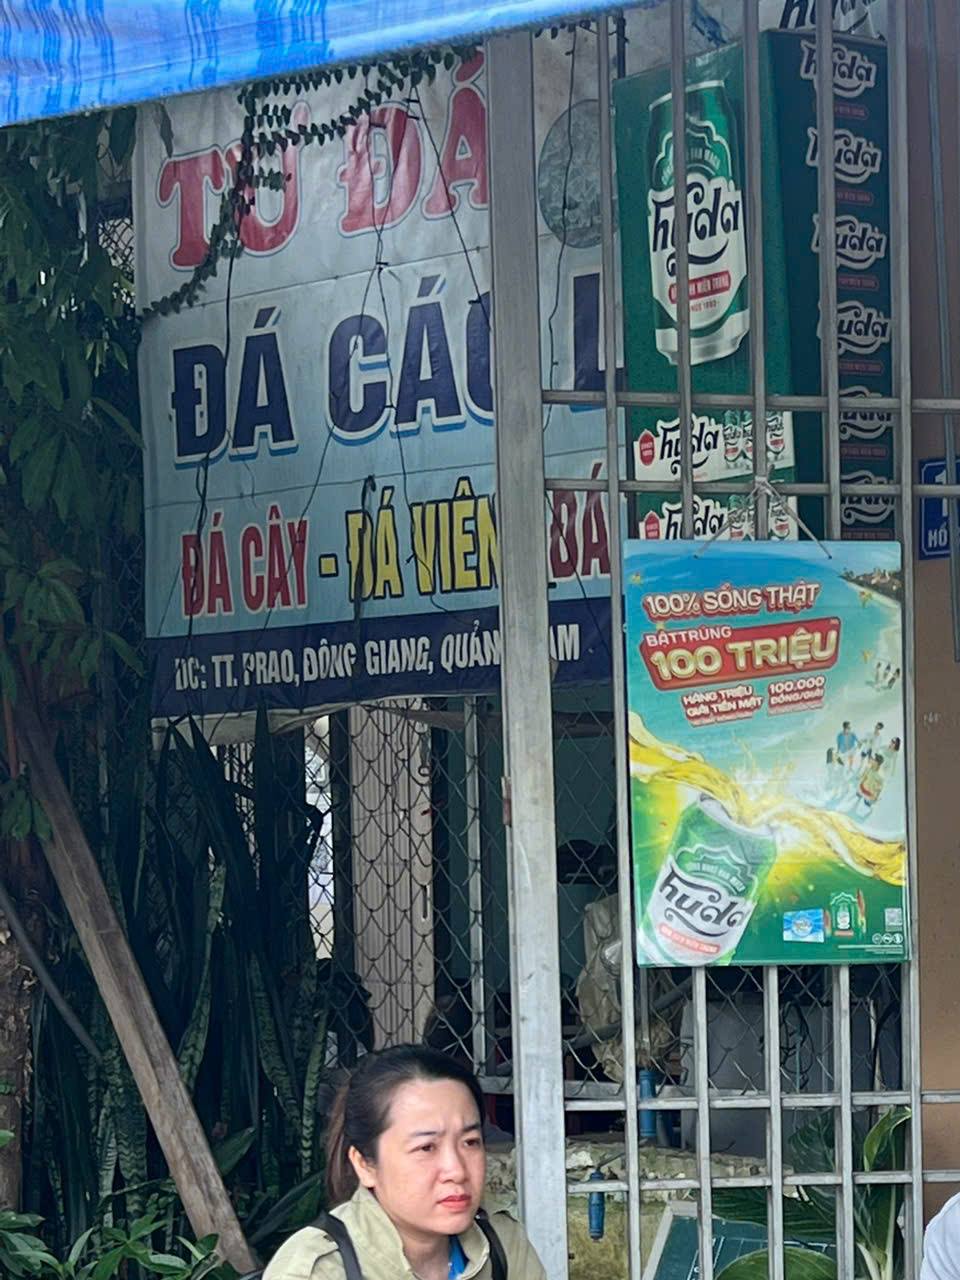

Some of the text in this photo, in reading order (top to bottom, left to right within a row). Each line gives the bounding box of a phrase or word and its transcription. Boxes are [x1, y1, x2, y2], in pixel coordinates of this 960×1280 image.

[340, 50, 489, 236] ĐÁ
[171, 306, 296, 458] ĐÁ
[181, 513, 232, 616] ĐÁ
[241, 505, 307, 610] CÂY
[346, 486, 403, 601] ĐÁ
[645, 592, 701, 614] 100%
[766, 581, 819, 608] THẬT
[212, 654, 237, 688] TT.
[243, 649, 299, 687] PRAO,
[365, 636, 433, 675] GIANG,
[650, 628, 838, 681] 100 TRIỆU
[770, 676, 825, 694] 100.000
